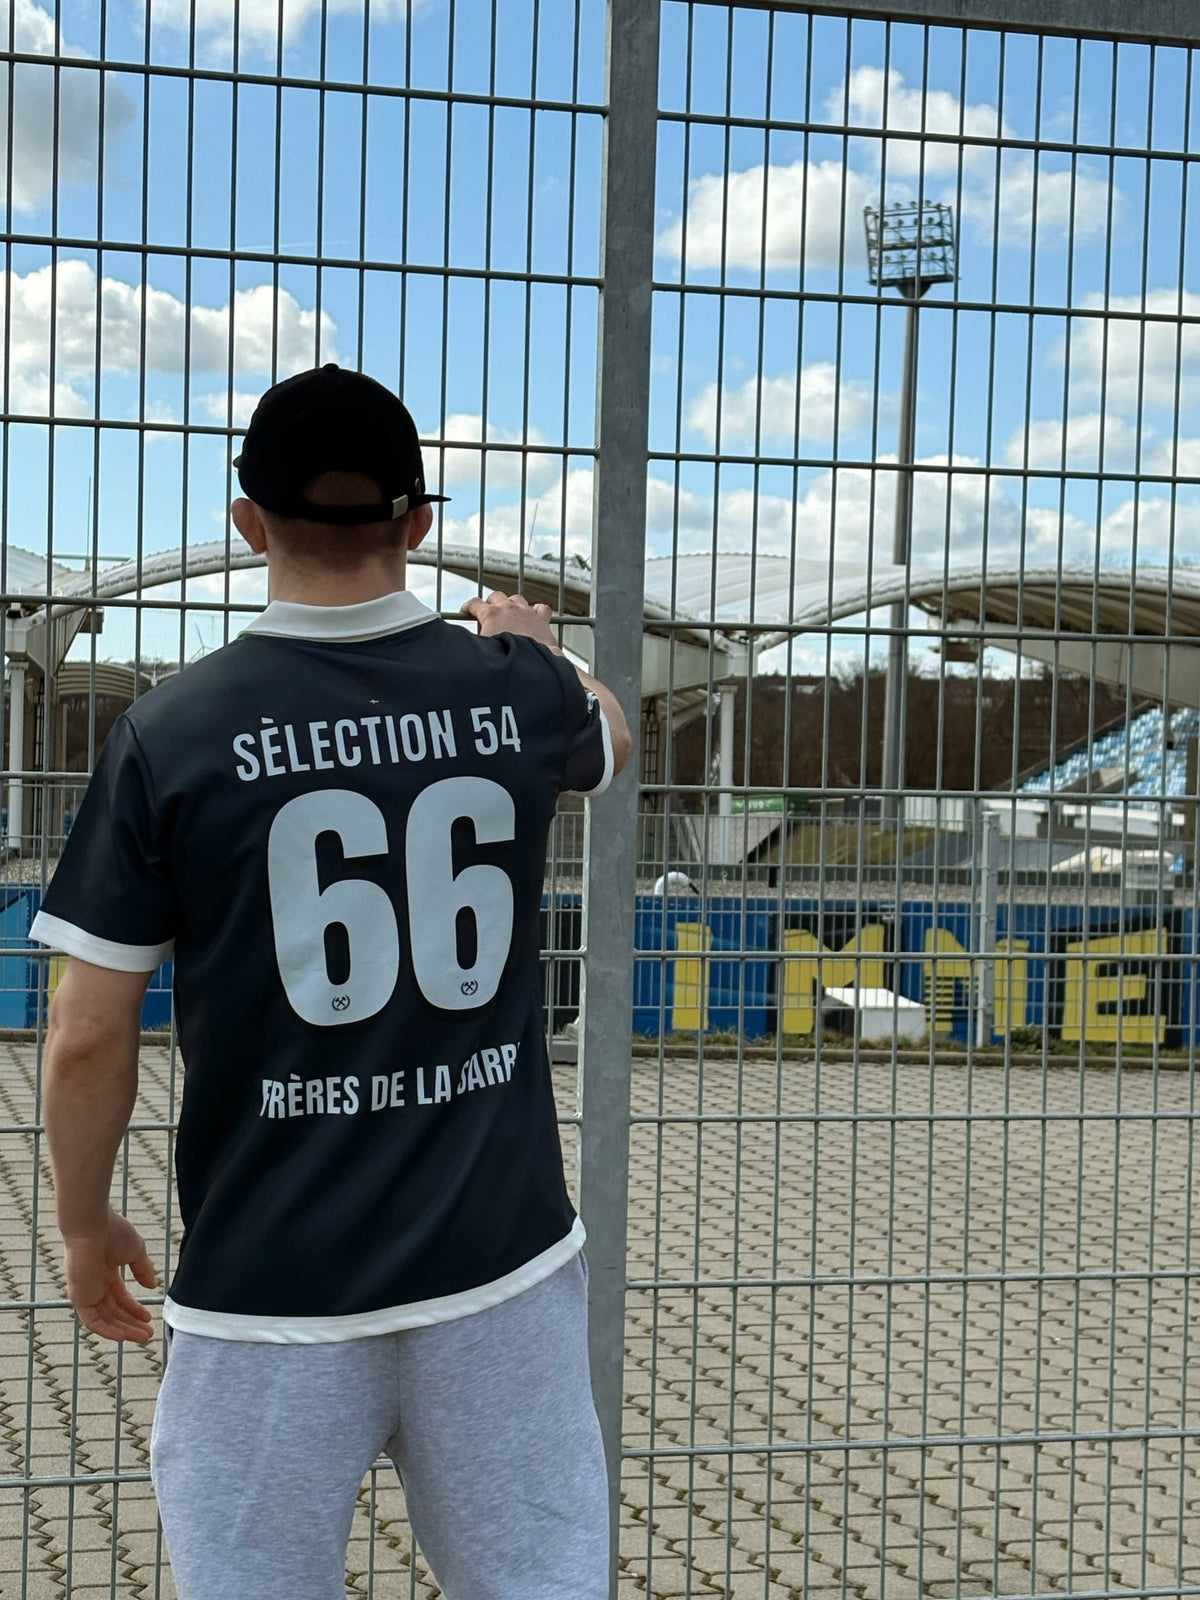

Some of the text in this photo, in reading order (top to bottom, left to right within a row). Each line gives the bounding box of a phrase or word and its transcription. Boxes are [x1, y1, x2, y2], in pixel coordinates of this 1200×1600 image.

[470, 706, 521, 756] 54
[268, 776, 515, 1027] 66
[371, 1070, 405, 1112] DE
[416, 1065, 452, 1105] LA
[456, 1041, 520, 1095] SARR
